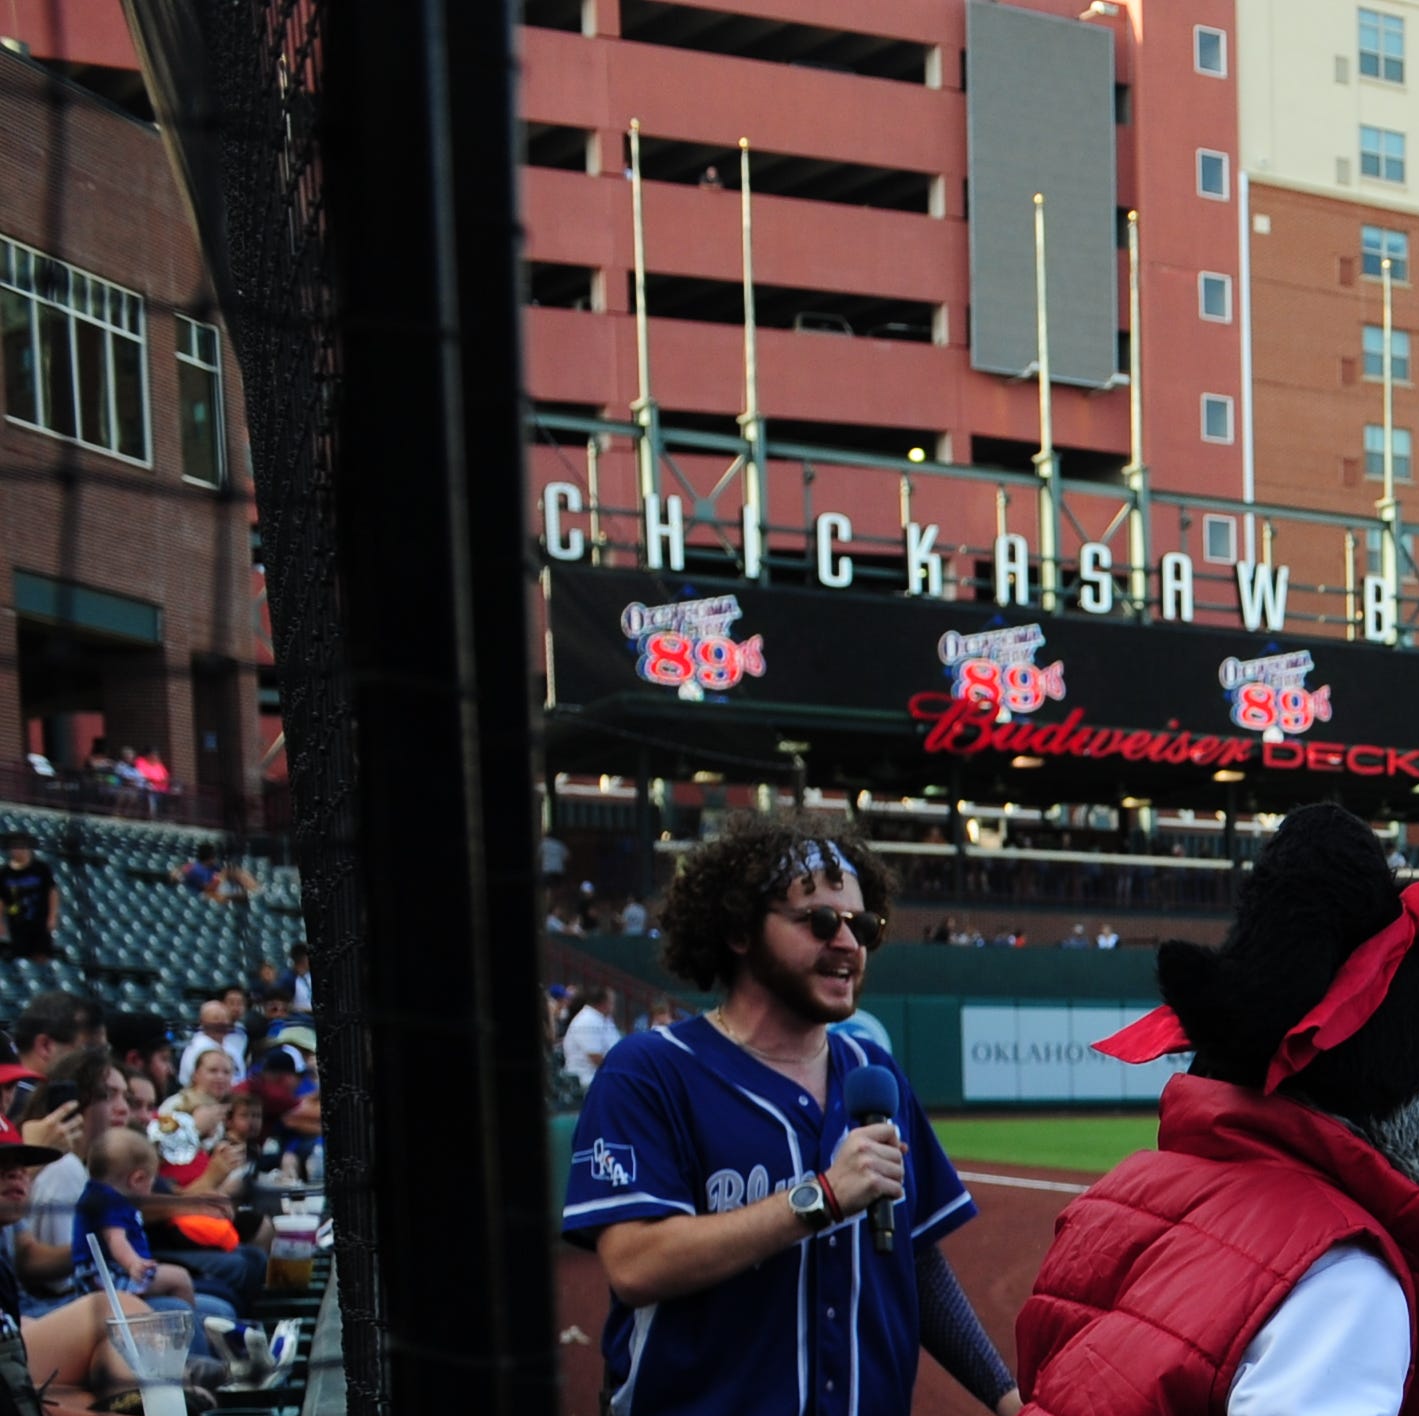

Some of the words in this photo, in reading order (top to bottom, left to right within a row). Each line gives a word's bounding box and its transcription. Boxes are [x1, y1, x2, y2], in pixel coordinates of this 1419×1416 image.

[542, 481, 1290, 632] CHICKASAW
[908, 692, 1253, 768] Budweiser
[971, 1040, 1113, 1064] OKLAHO
